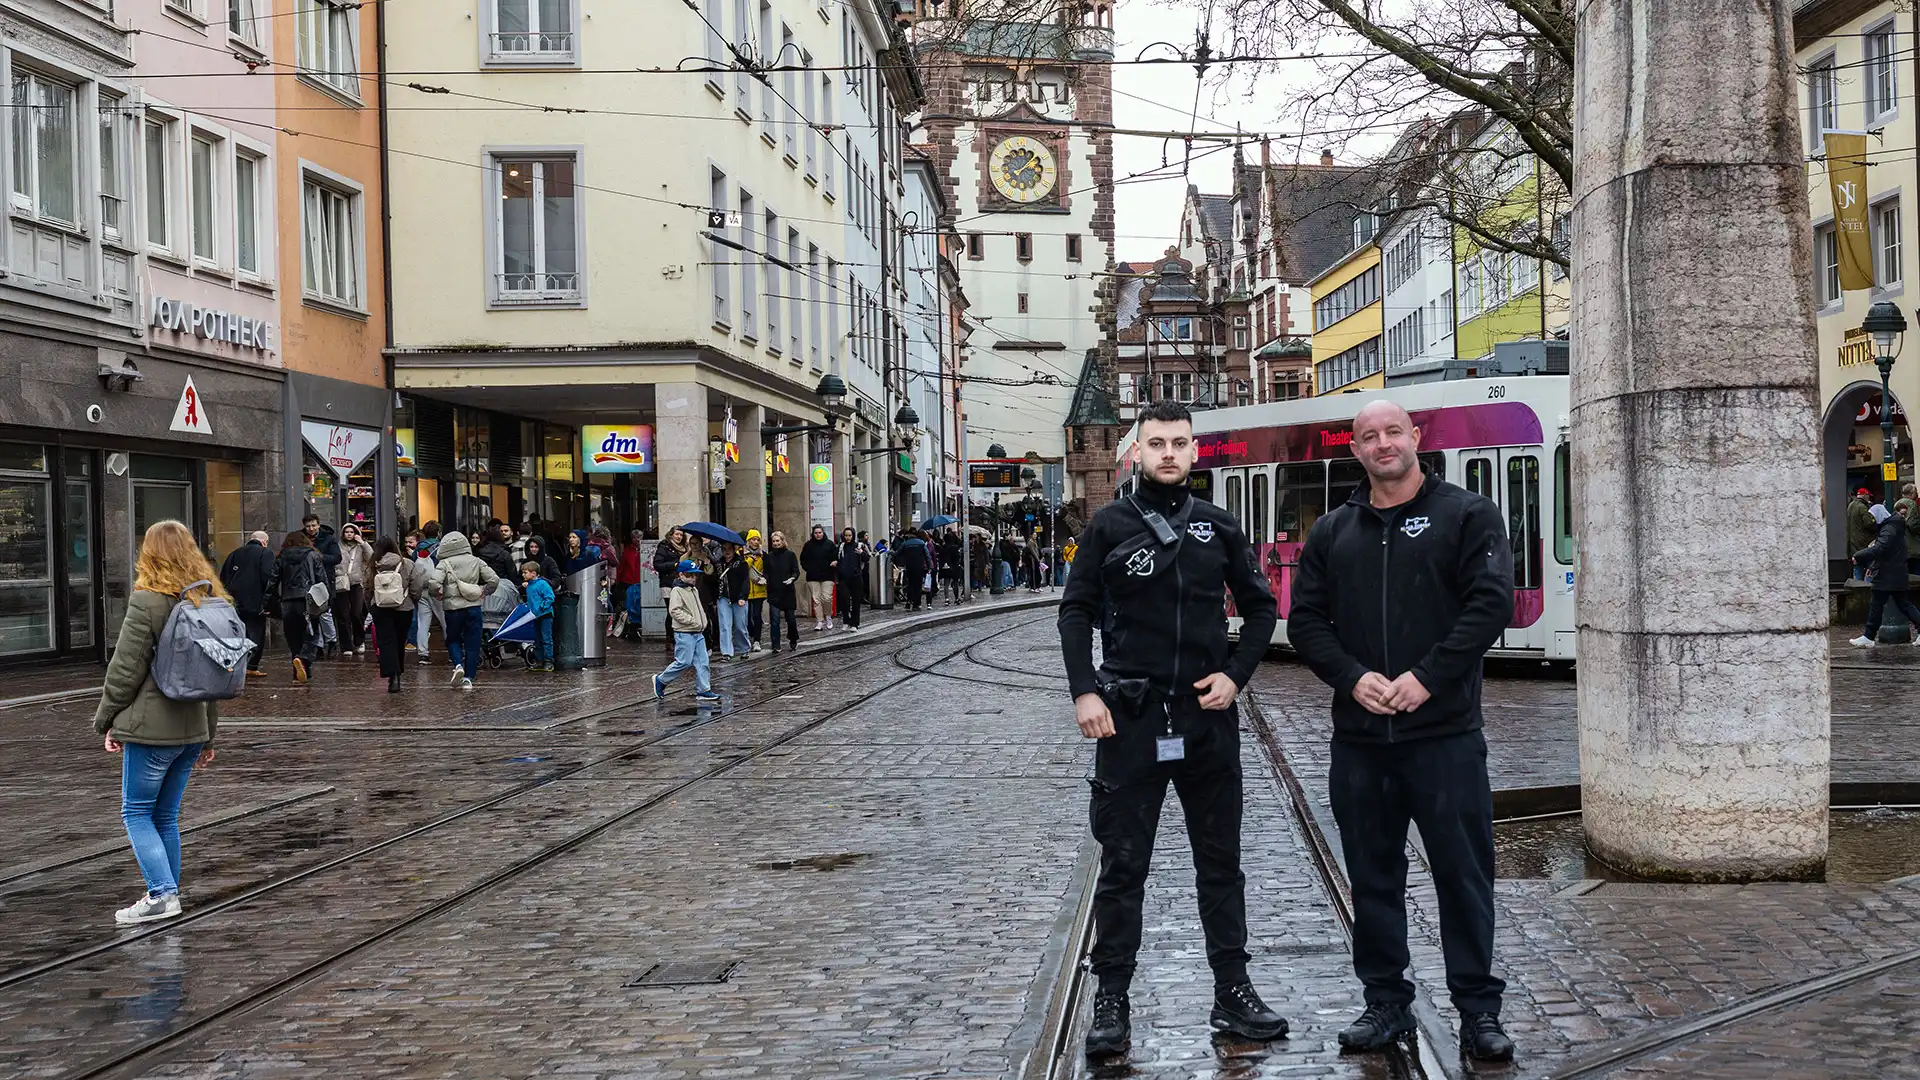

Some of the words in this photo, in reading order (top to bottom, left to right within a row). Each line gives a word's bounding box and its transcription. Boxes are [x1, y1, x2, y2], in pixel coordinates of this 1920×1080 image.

[729, 216, 739, 224] VA
[1488, 385, 1506, 398] 260
[1873, 402, 1904, 415] vda
[601, 432, 637, 452] dm
[1320, 429, 1354, 447] Theater
[1198, 444, 1216, 457] eater
[1216, 440, 1248, 457] Freiburg
